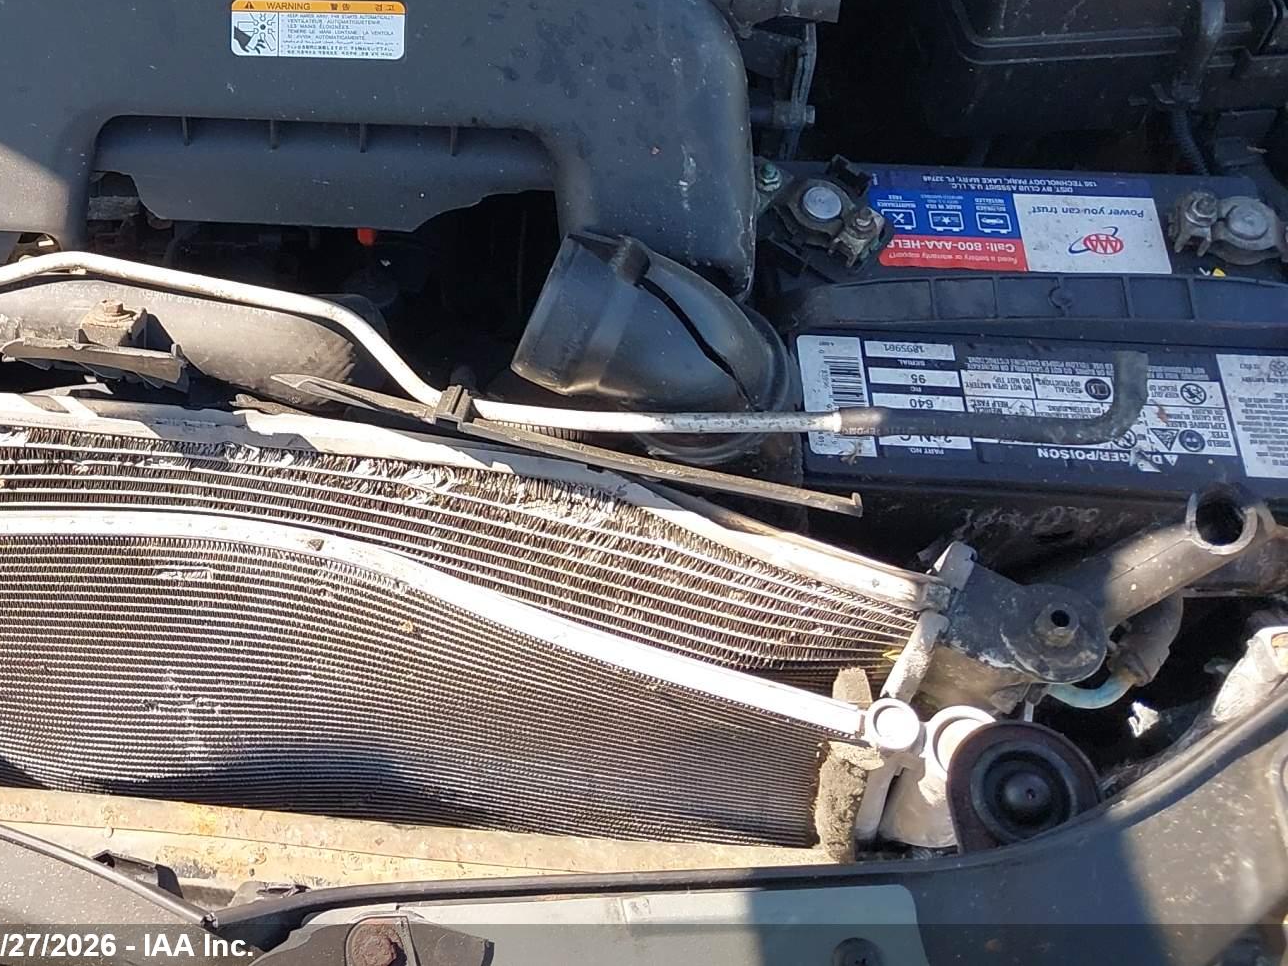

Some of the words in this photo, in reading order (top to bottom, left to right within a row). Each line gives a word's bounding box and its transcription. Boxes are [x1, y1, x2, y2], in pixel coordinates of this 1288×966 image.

[266, 2, 311, 11] WARNING
[1084, 206, 1105, 216] you
[1108, 209, 1144, 218] Power
[985, 242, 1015, 252] Call:
[910, 374, 926, 383] 95
[909, 399, 934, 409] 640
[1037, 447, 1163, 464] DGER/POISON
